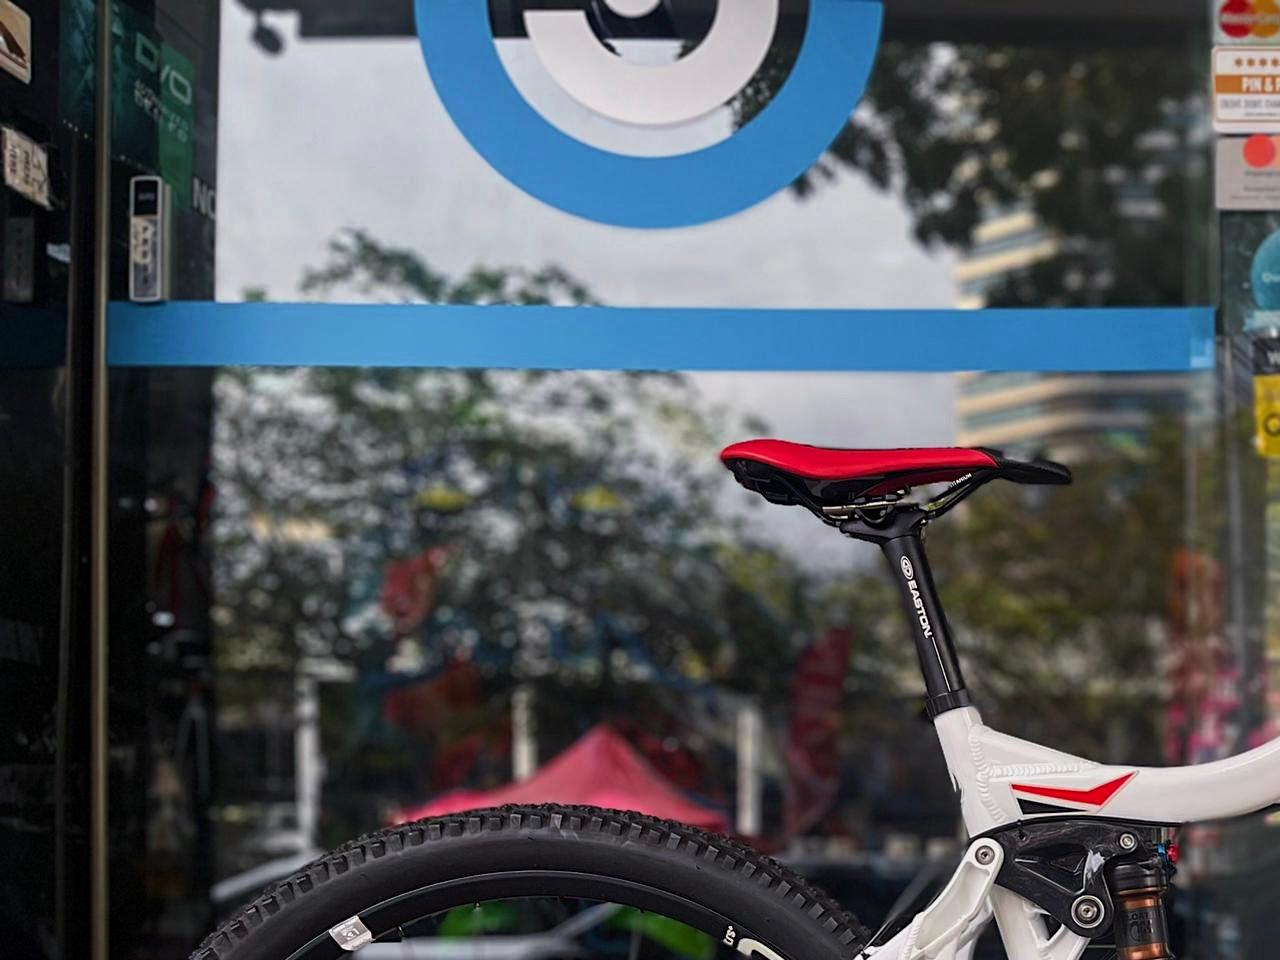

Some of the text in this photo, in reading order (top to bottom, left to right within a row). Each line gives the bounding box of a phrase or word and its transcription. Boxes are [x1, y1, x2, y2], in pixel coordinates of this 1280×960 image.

[1241, 77, 1262, 92] PIN
[1264, 78, 1273, 92] &
[907, 579, 933, 639] EASTON
